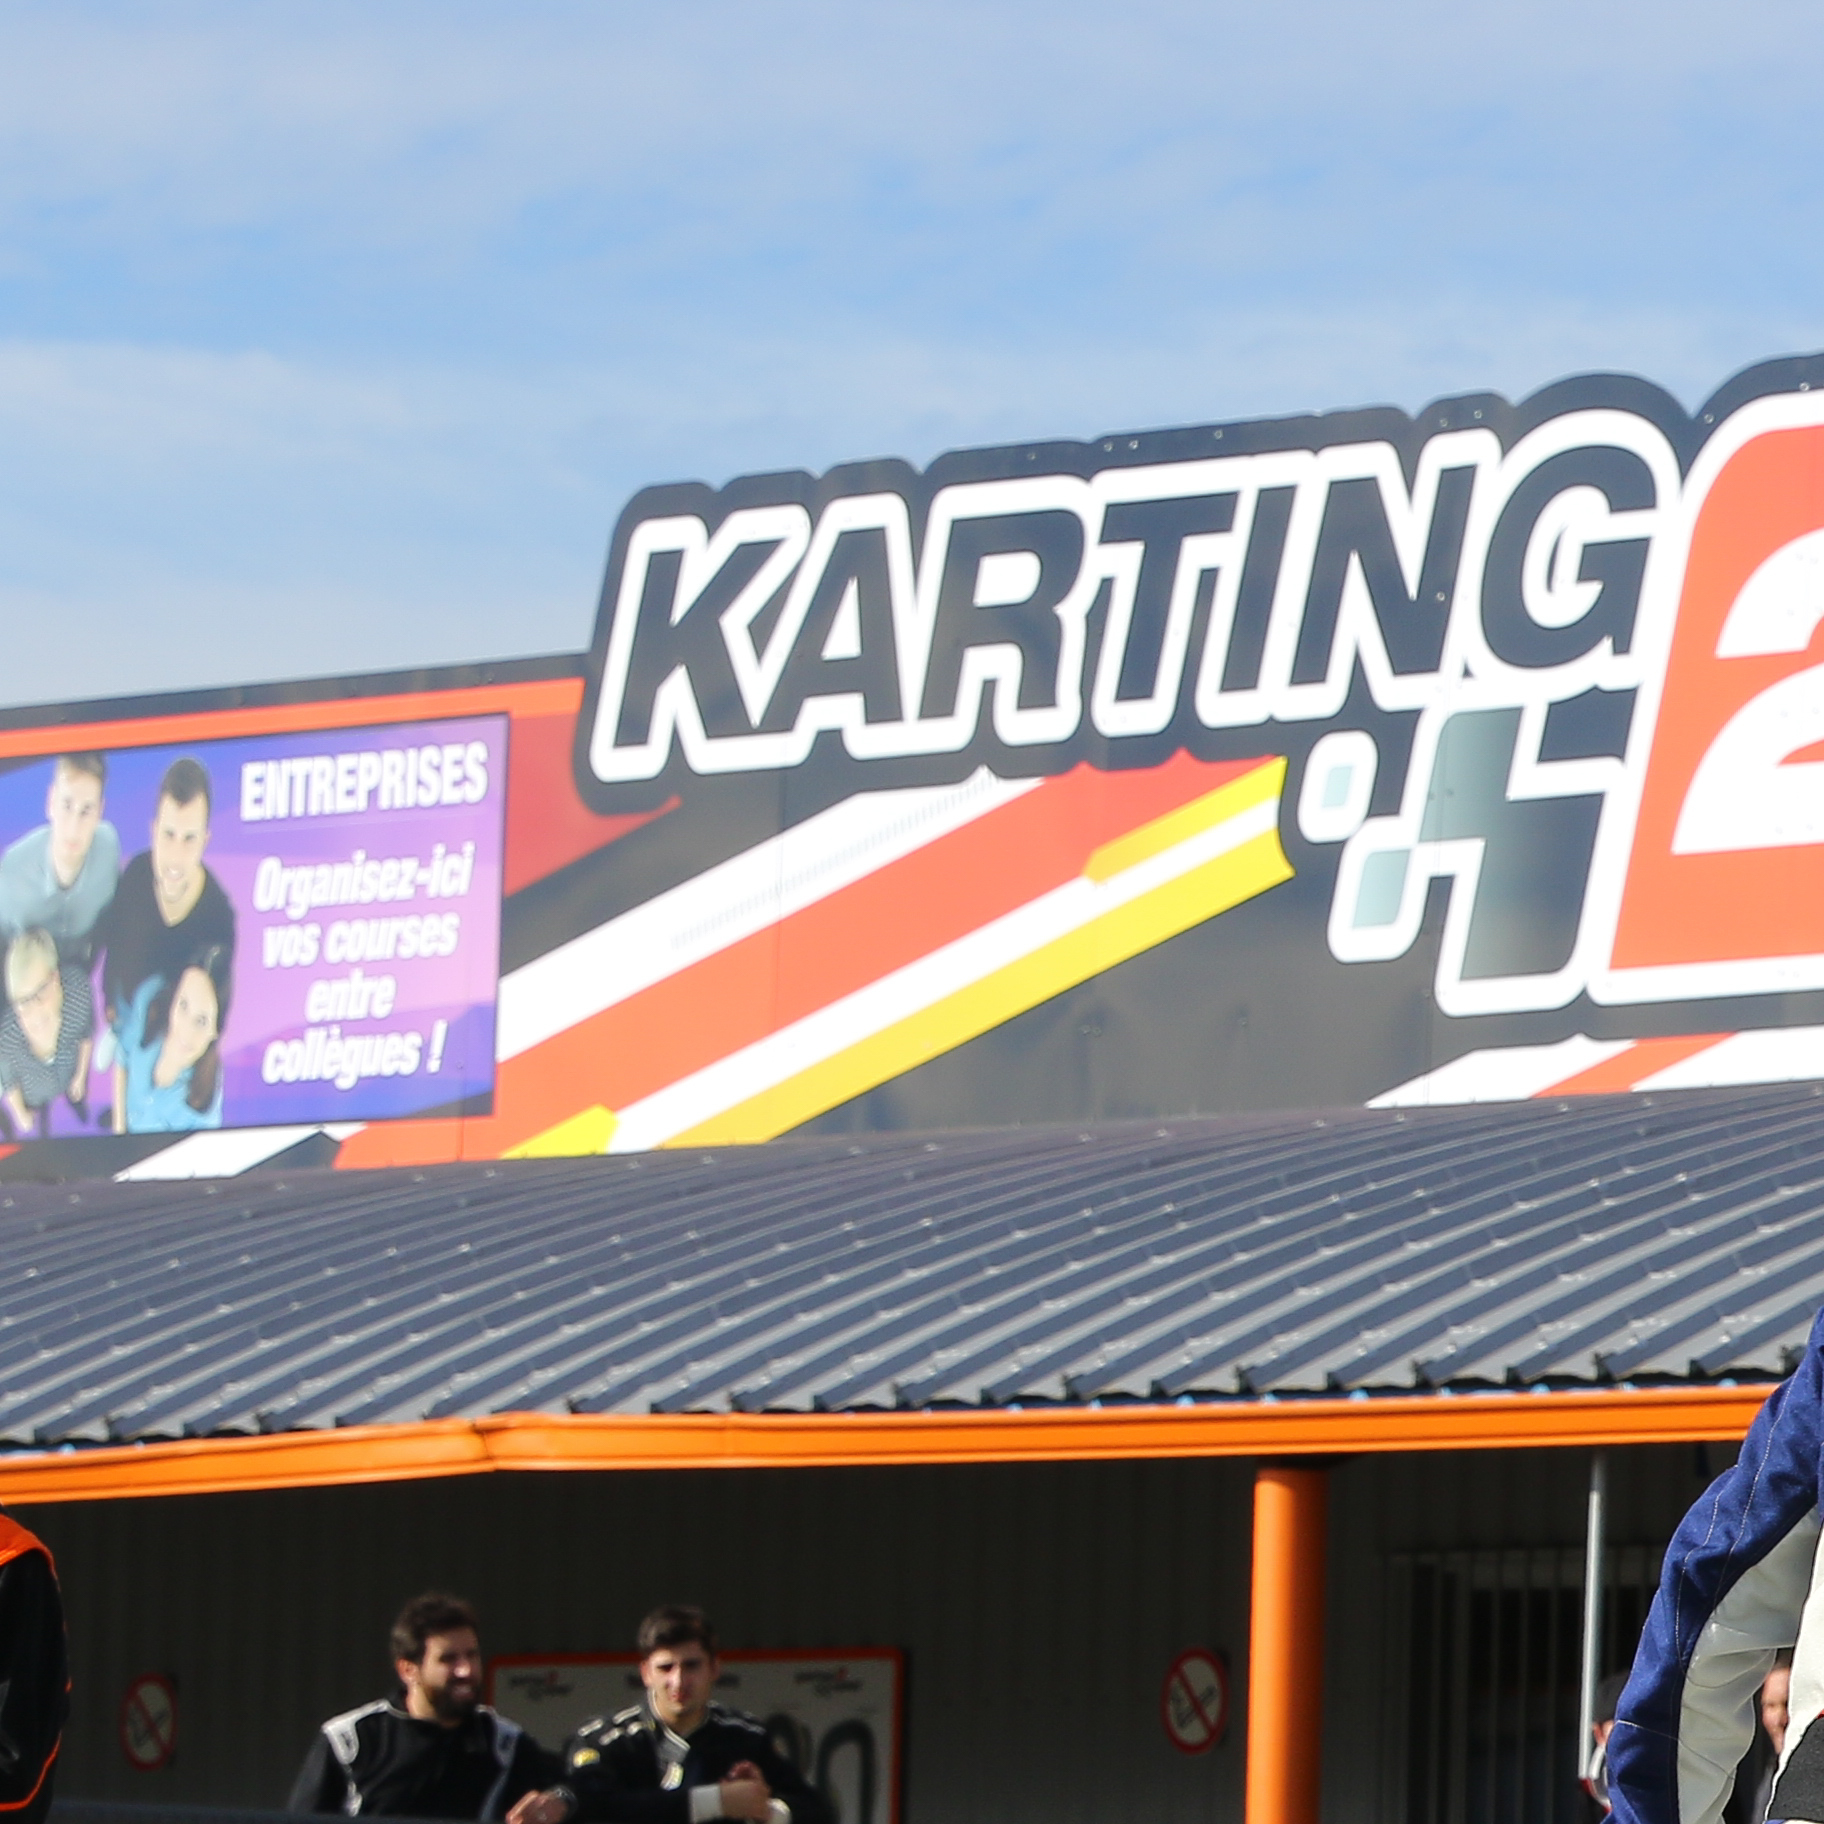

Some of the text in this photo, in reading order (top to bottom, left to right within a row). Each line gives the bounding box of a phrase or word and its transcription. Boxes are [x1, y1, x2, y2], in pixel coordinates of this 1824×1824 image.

[605, 430, 1668, 762] KARTING
[240, 741, 489, 822] ENTREPRISES
[253, 842, 477, 919] Organisez-ici
[262, 912, 458, 969] vos courses
[306, 968, 396, 1022] entre
[262, 1029, 420, 1090] collègues
